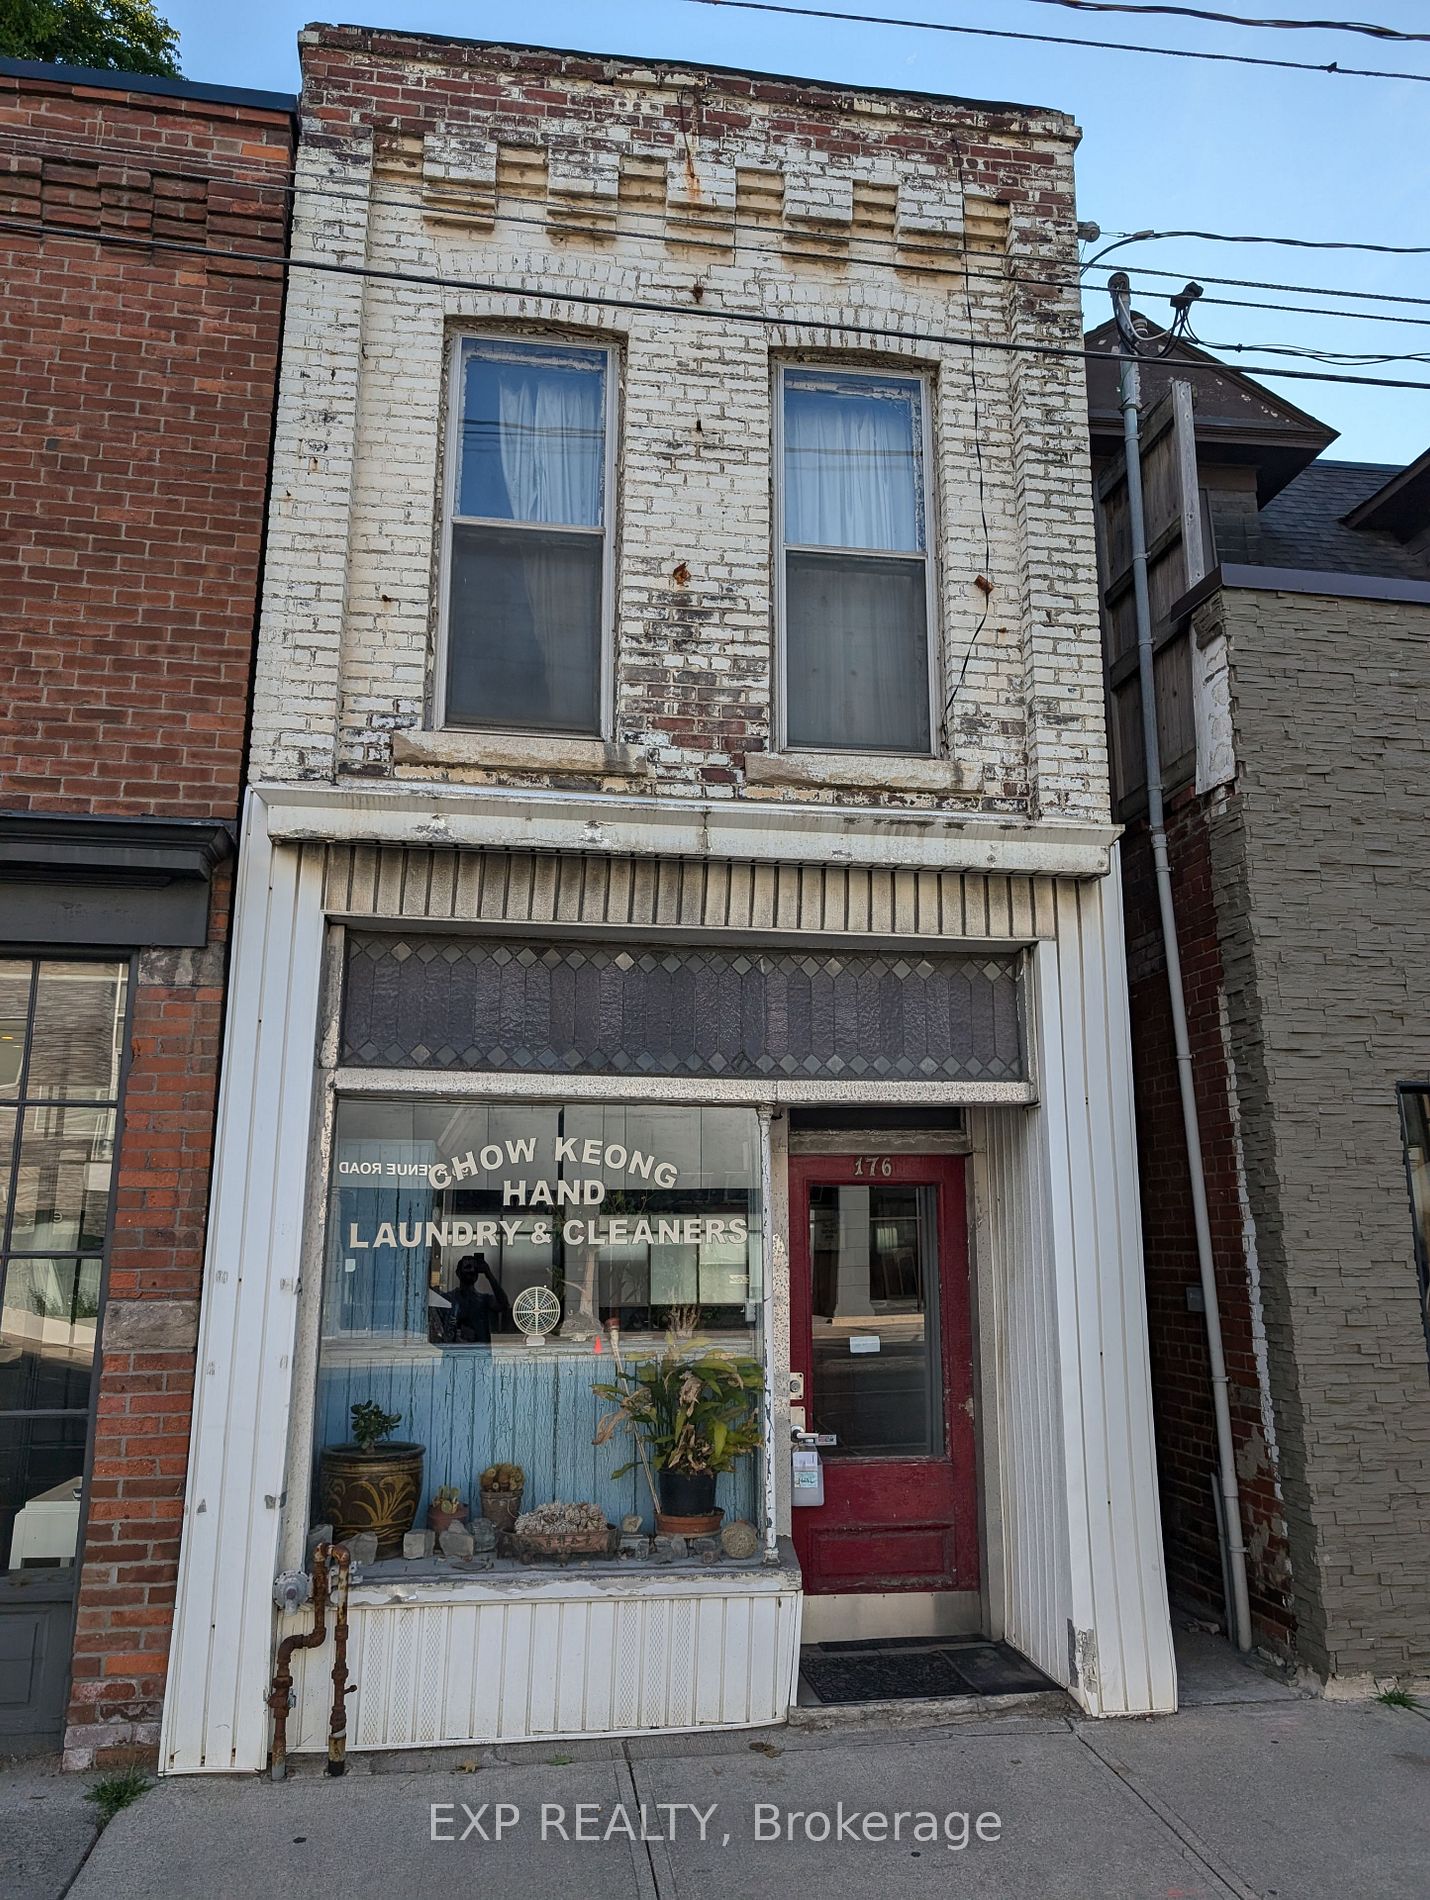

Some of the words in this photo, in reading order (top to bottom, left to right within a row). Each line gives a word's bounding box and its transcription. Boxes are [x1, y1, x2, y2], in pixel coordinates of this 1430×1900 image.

[428, 1137, 537, 1190] CHOW
[554, 1136, 679, 1189] KEONG
[854, 1156, 892, 1177] 176
[503, 1179, 606, 1206] HAND
[349, 1220, 523, 1248] LAUNDRY
[530, 1221, 553, 1245] &
[562, 1218, 749, 1246] CLEANERS
